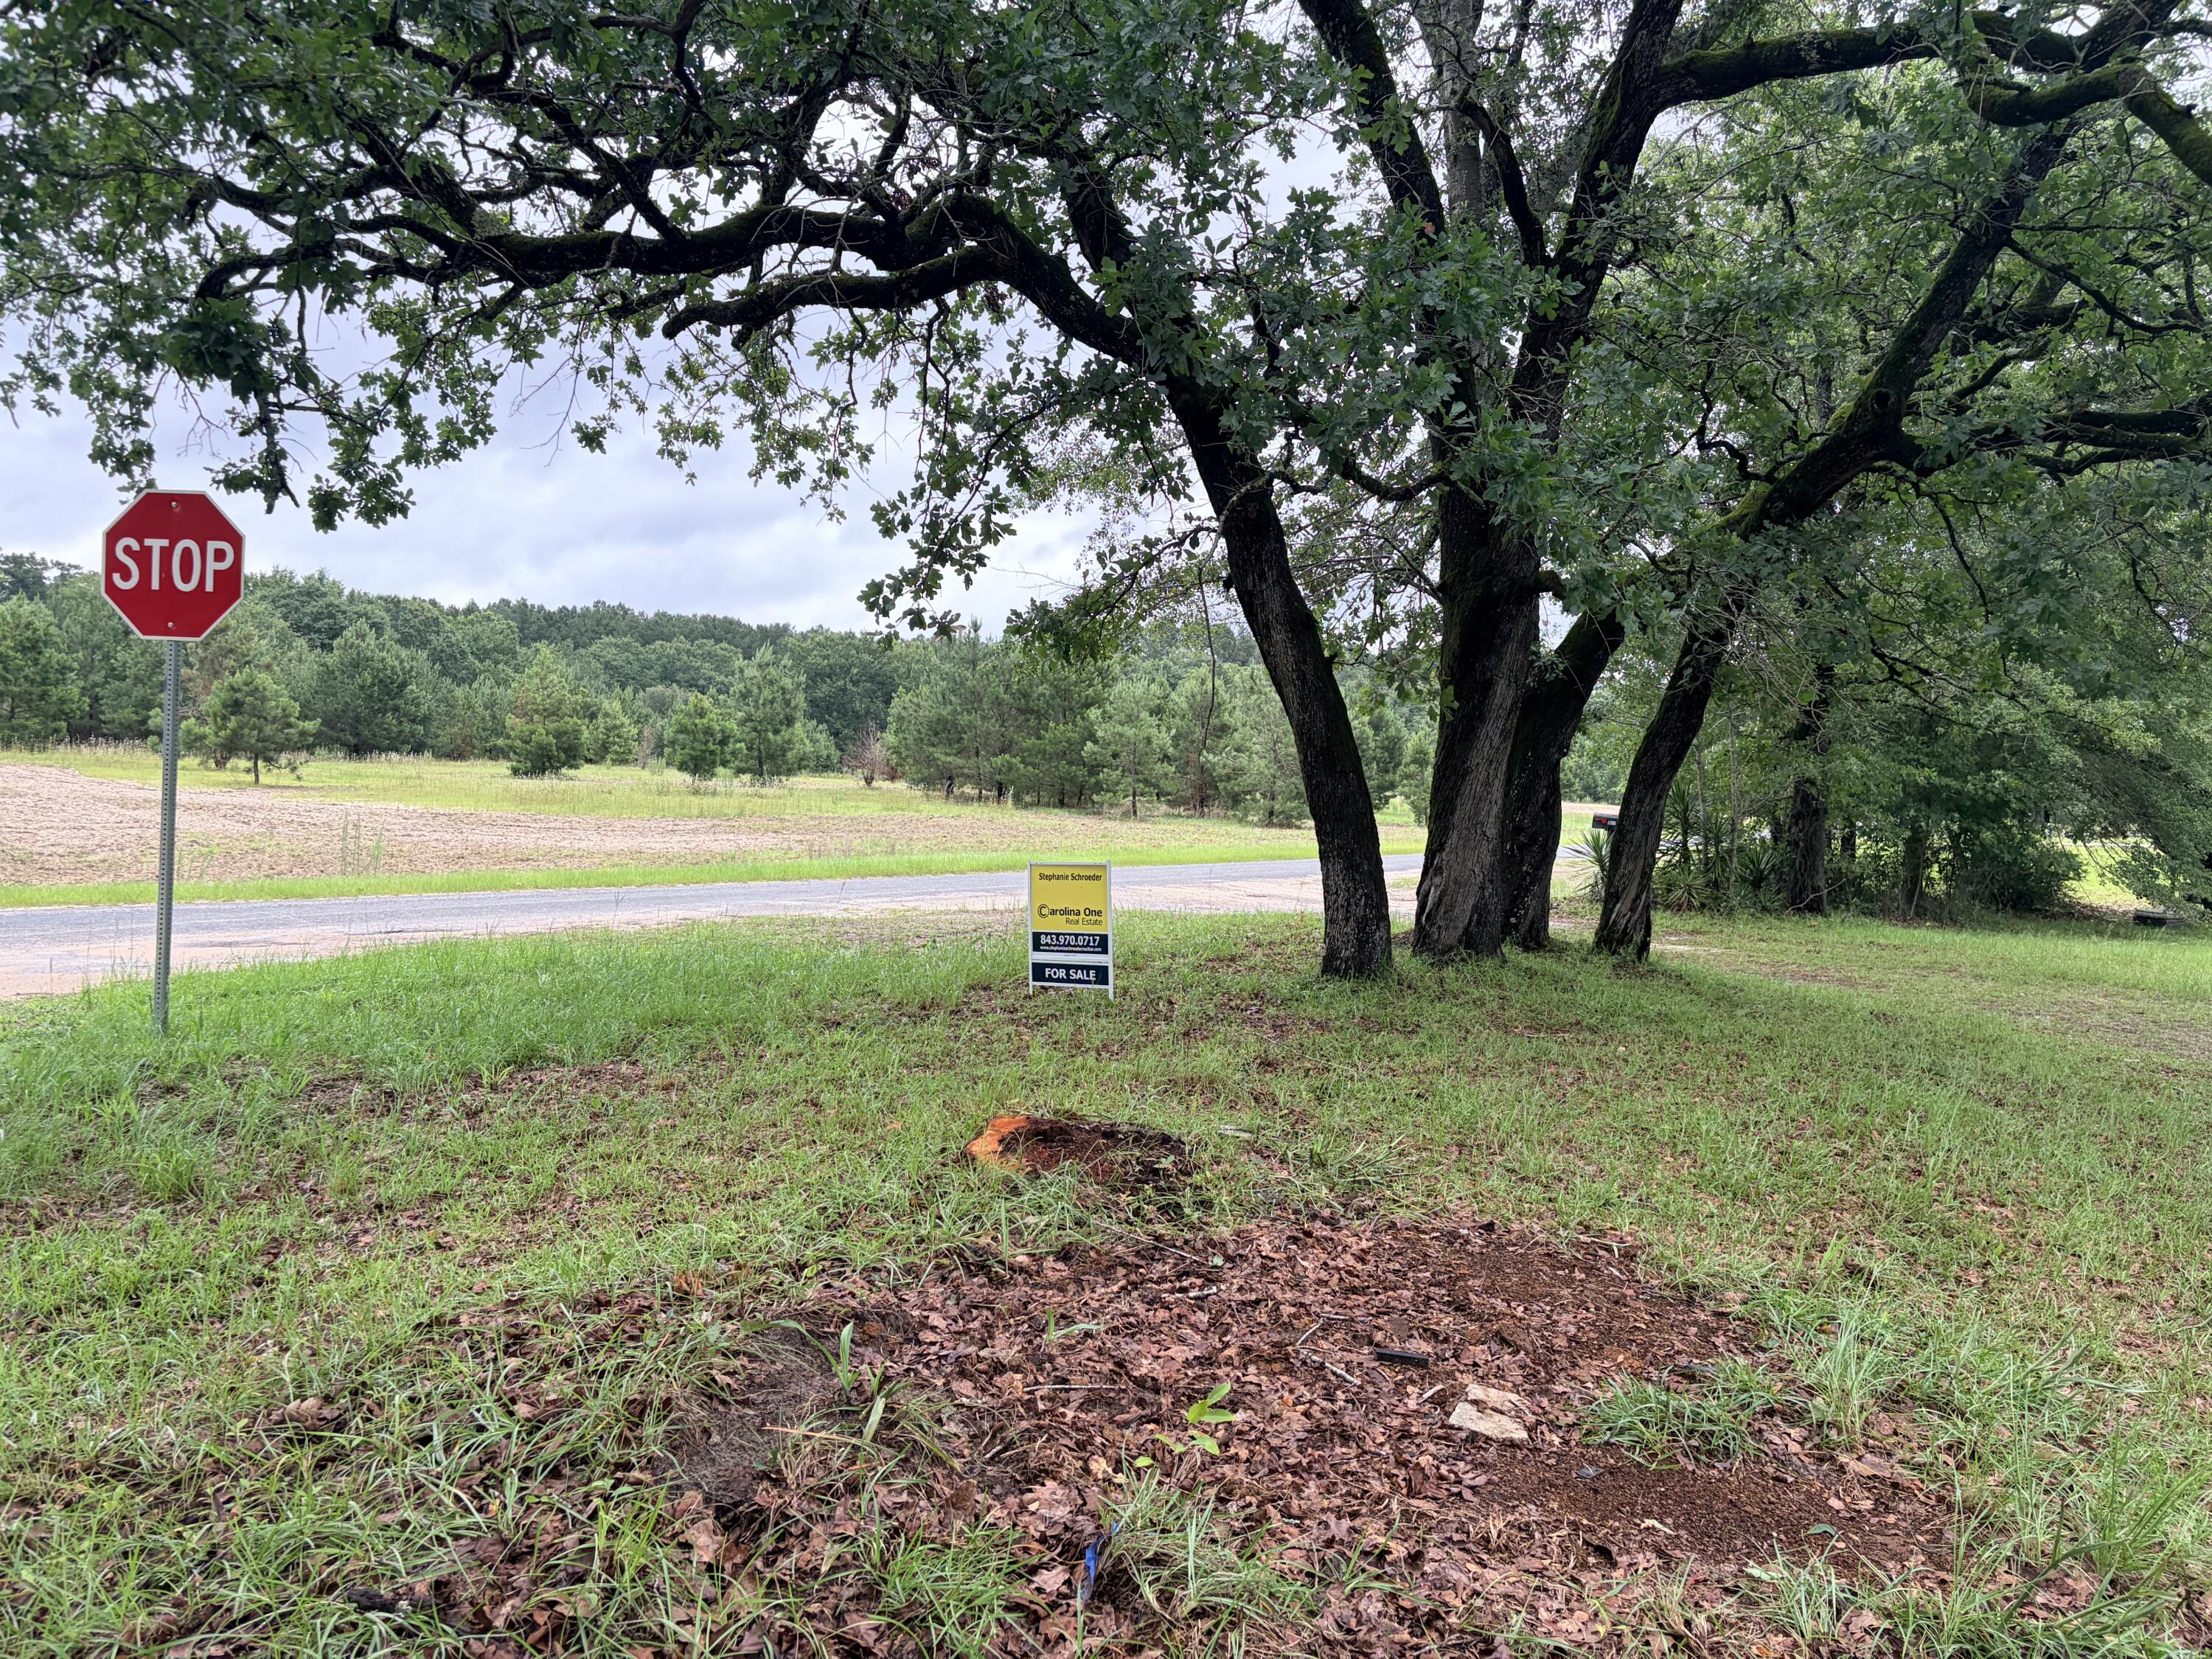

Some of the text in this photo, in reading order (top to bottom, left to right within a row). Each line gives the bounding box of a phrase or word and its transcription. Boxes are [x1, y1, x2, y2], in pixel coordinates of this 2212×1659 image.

[112, 537, 234, 592] STOP
[1039, 872, 1102, 882] Stephanie Schroeder
[1037, 904, 1102, 918] Carolina One
[1082, 918, 1103, 926] Estate
[1040, 934, 1100, 946] 843.970.0717
[1045, 967, 1096, 981] FOR SALE
